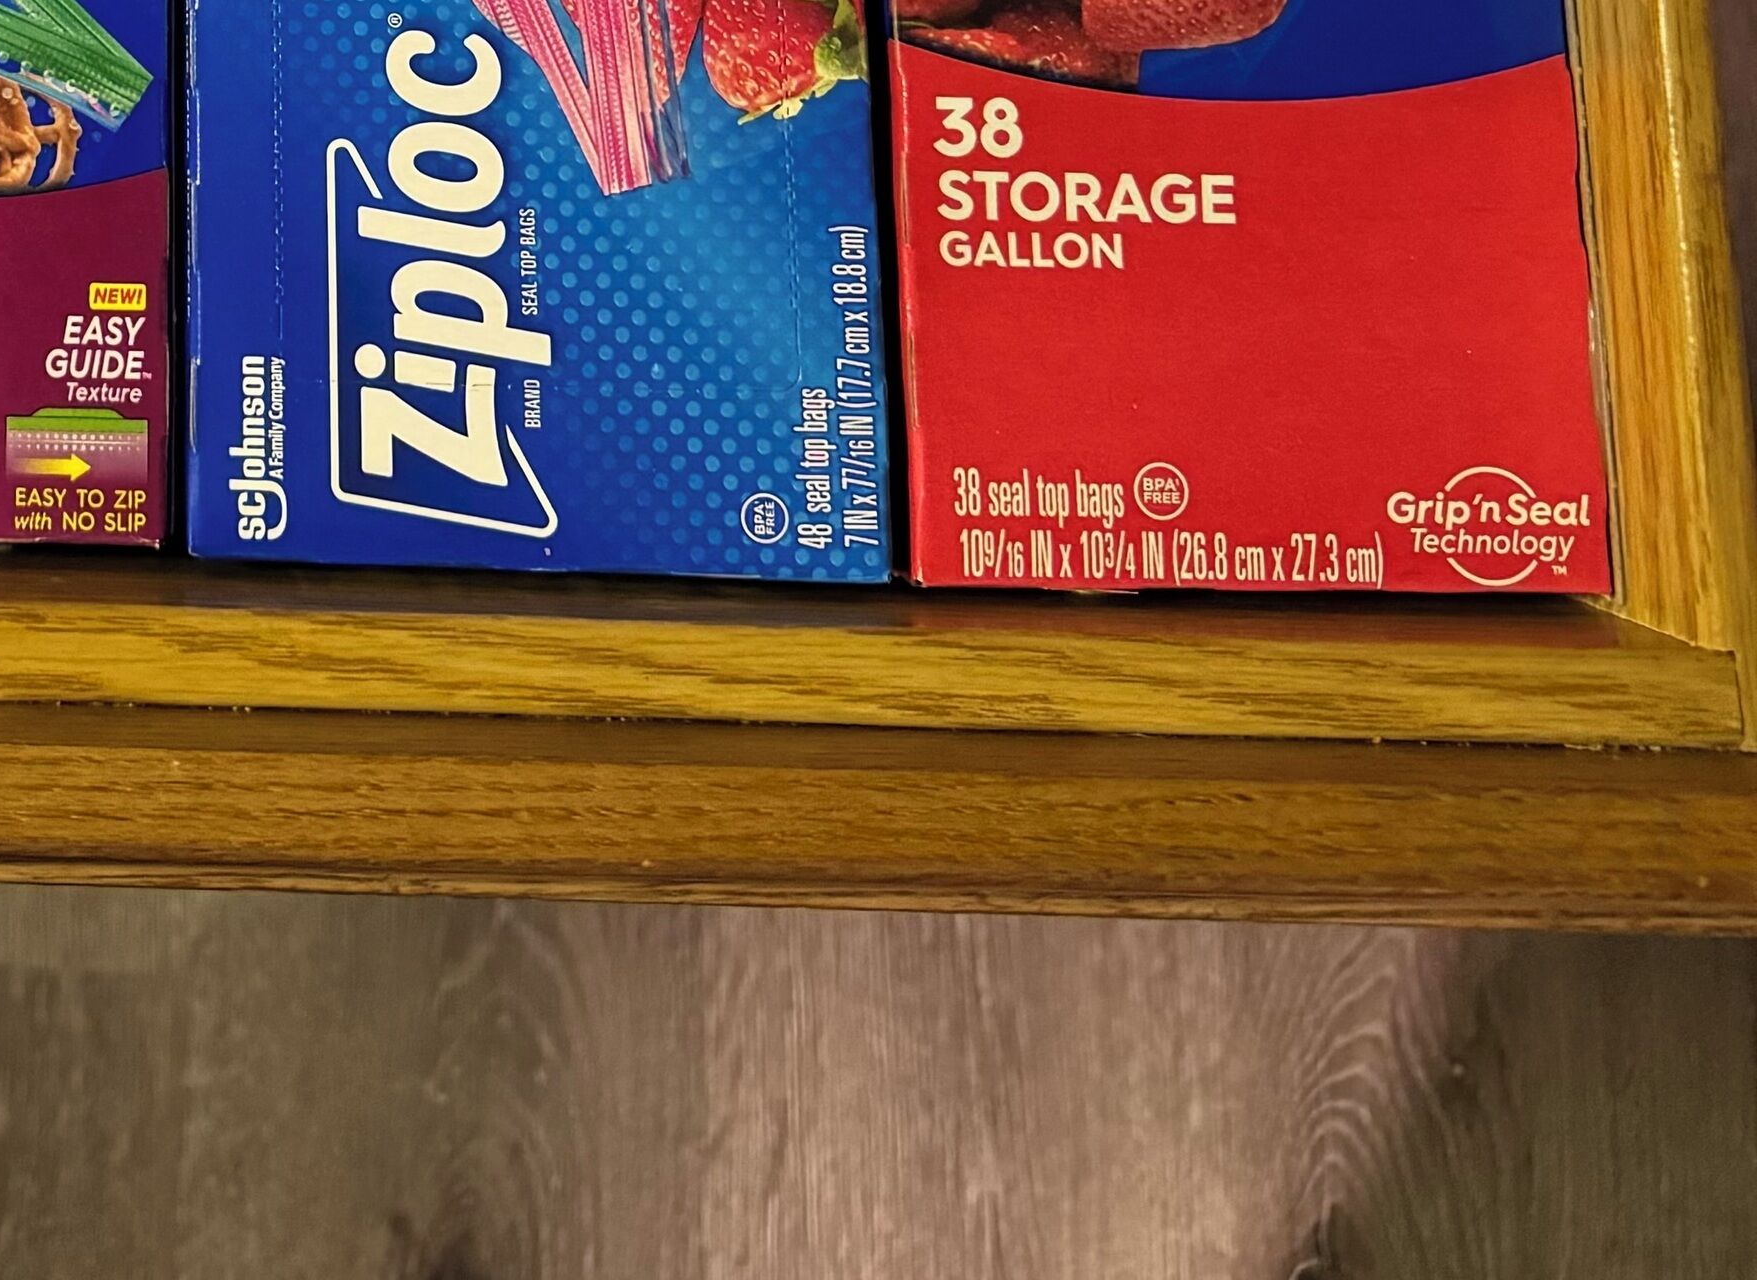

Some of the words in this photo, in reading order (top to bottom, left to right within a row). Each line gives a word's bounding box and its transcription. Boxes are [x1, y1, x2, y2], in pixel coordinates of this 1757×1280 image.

[932, 96, 1023, 159] 38
[937, 169, 1237, 225] STORAGE
[519, 207, 535, 240] BAGS
[521, 243, 538, 276] TOP
[828, 225, 869, 260] cm)
[939, 229, 1125, 269] GALLON
[93, 288, 143, 305] NEW!
[522, 280, 539, 315] SEAL
[831, 264, 868, 305] 18.8
[63, 315, 146, 346] EASY
[66, 381, 143, 403] Texture
[269, 356, 288, 420] Company
[836, 357, 877, 409] (17.7
[524, 378, 542, 429] BRAND
[793, 388, 836, 433] bags
[269, 422, 288, 466] Family
[800, 438, 837, 467] top
[15, 487, 67, 507] EASY
[76, 488, 105, 508] TO
[114, 490, 147, 509] ZIP
[795, 473, 832, 514] seal
[953, 466, 981, 517] 38
[988, 468, 1030, 518] seal
[1037, 473, 1069, 529] top
[1075, 469, 1125, 528] bags
[1142, 477, 1175, 492] BPA
[1143, 491, 1181, 505] FREE
[14, 512, 52, 531] with
[62, 512, 95, 531] NO
[104, 512, 147, 532] SLIP
[1505, 493, 1591, 527] Seal
[797, 522, 833, 550] 48
[1410, 527, 1575, 562] Technology
[1172, 528, 1228, 587] (26.8
[1290, 533, 1340, 583] 27.3
[1345, 531, 1384, 589] cm)
